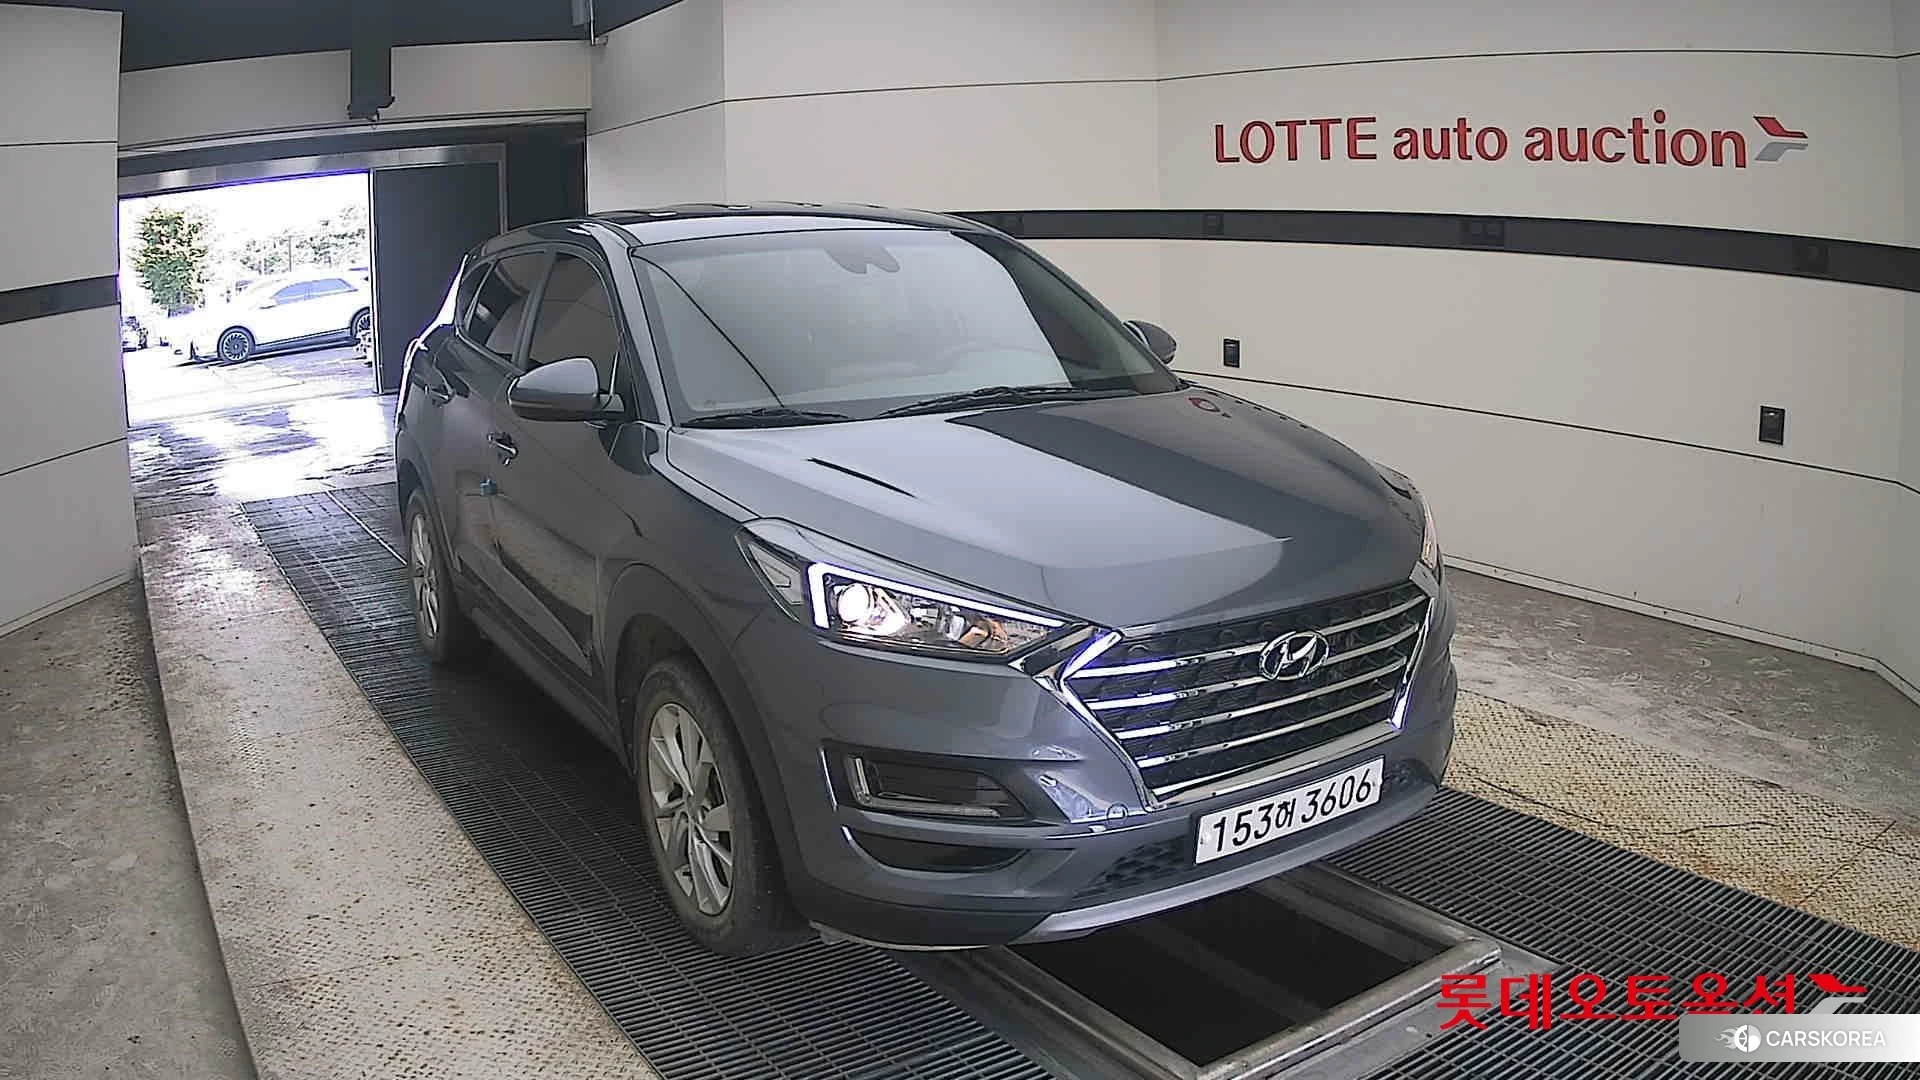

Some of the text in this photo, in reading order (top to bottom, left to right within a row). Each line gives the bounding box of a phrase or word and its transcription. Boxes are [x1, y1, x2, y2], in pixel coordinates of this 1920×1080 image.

[1215, 110, 1747, 168] LOTTE auto auction
[1213, 768, 1372, 852] 153허 3606
